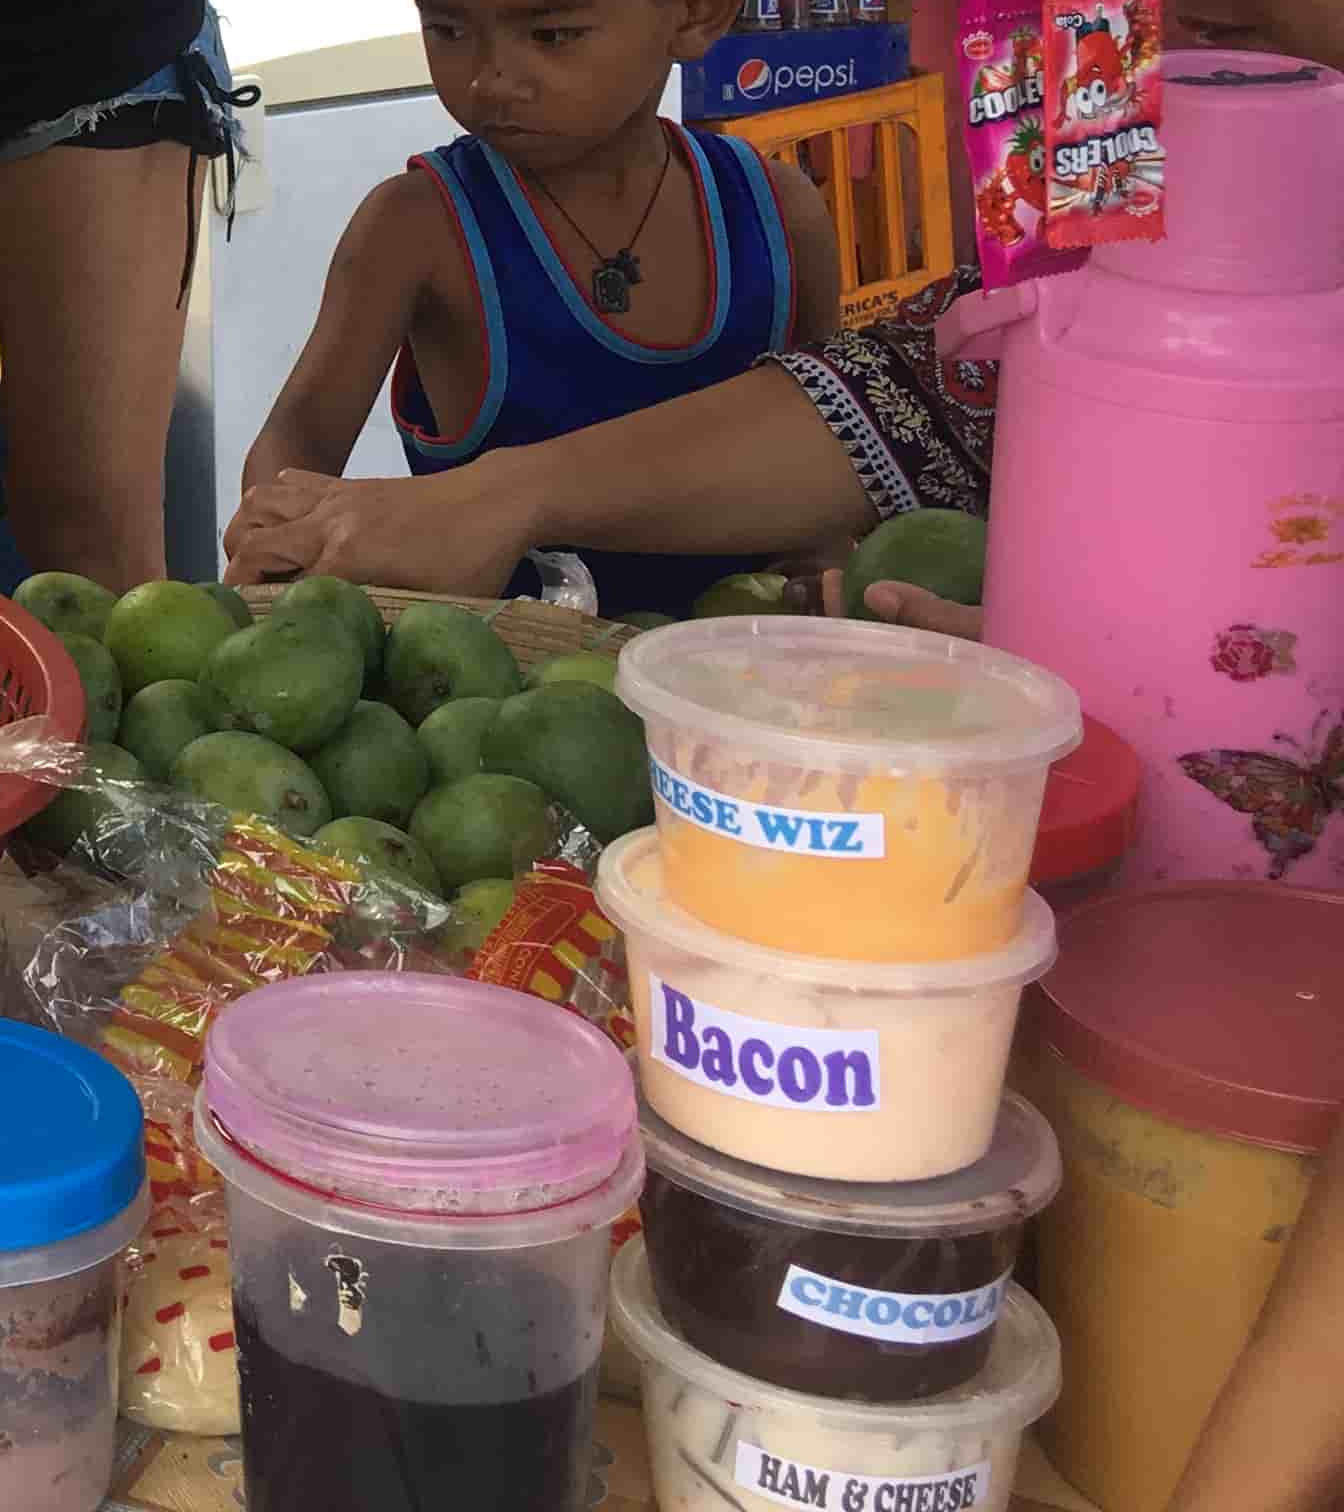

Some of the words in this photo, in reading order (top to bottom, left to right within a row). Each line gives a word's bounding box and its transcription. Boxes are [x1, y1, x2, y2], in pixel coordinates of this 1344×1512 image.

[1054, 13, 1084, 29] Cola
[773, 58, 856, 101] pepsi
[1055, 125, 1160, 176] COOLERS
[648, 754, 743, 836] HEESE
[757, 809, 865, 855] WIZ
[660, 982, 875, 1108] Bacon
[790, 1274, 1002, 1331] CHOCOLA
[757, 1454, 832, 1509] HAM
[842, 1476, 871, 1512] &
[872, 1470, 978, 1512] CHEESE
